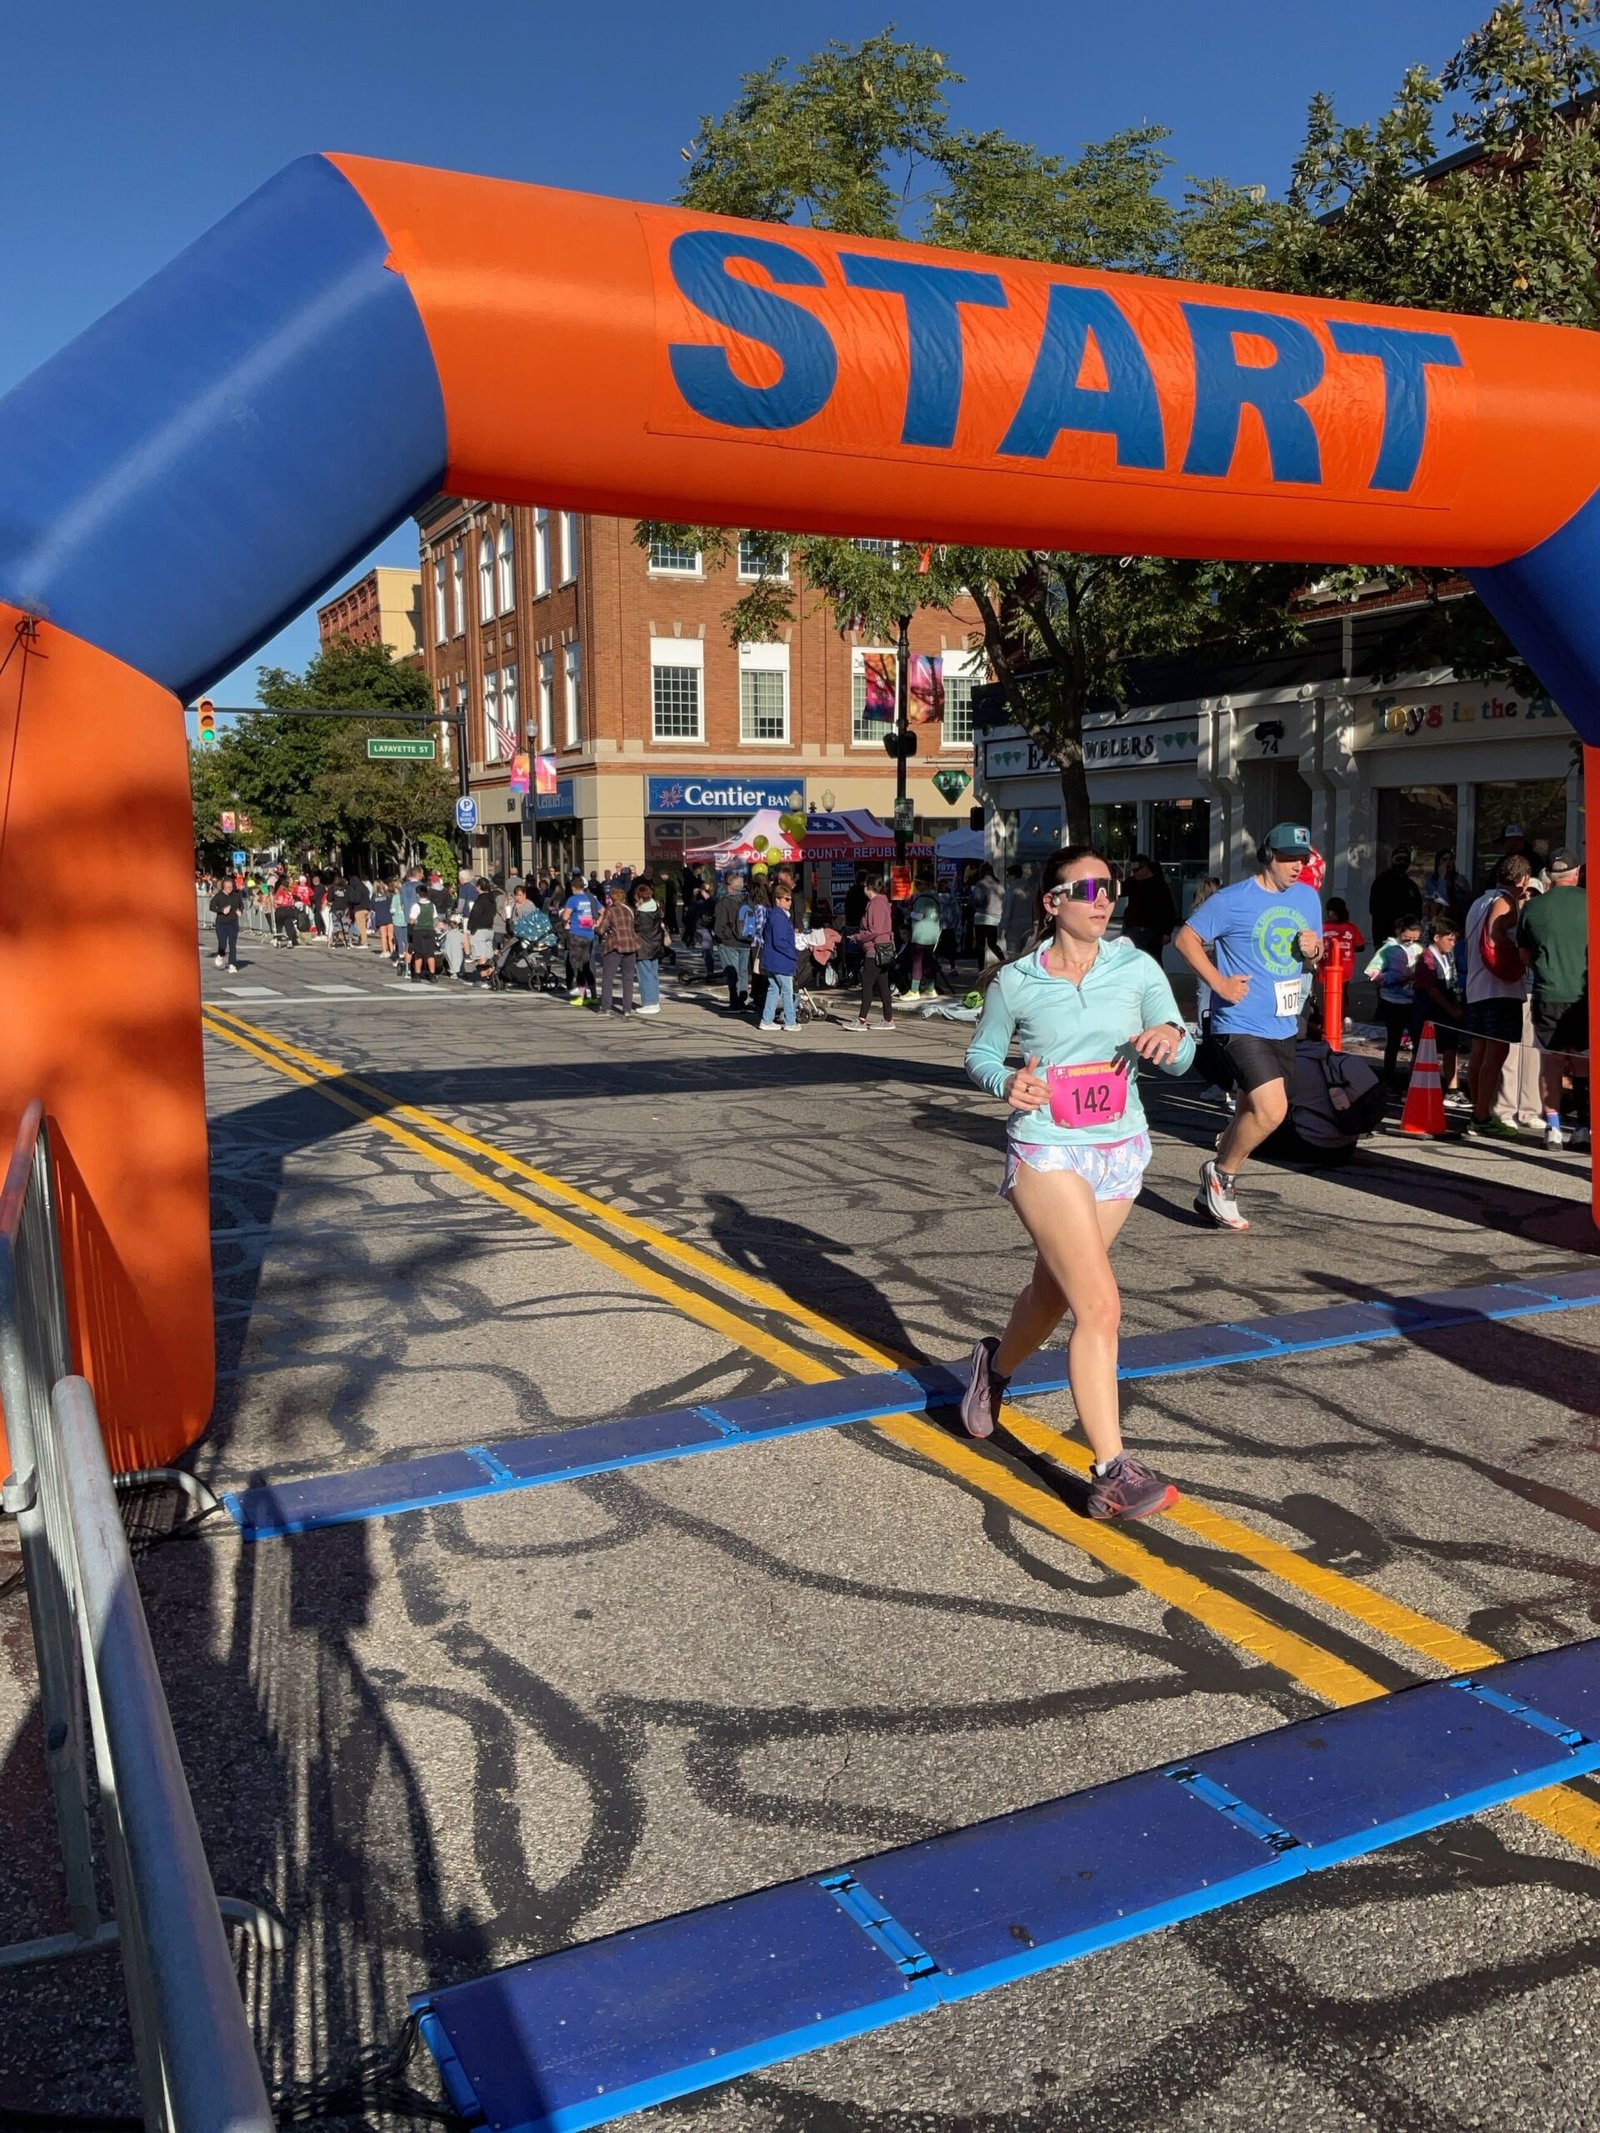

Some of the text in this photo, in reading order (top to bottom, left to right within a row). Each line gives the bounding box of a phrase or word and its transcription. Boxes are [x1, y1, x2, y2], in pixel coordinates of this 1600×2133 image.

[668, 229, 1463, 492] START
[1371, 696, 1443, 736] Toys
[1452, 702, 1475, 722] in
[1481, 697, 1518, 719] the
[373, 745, 417, 753] LAFAYETTE
[1085, 734, 1155, 759] WELERS
[1261, 739, 1279, 755] 74
[463, 800, 471, 809] P
[684, 785, 790, 807] Centier BAN
[799, 848, 848, 860] COUNTY
[853, 846, 933, 858] REPUBLCANS
[1071, 1085, 1111, 1115] 142
